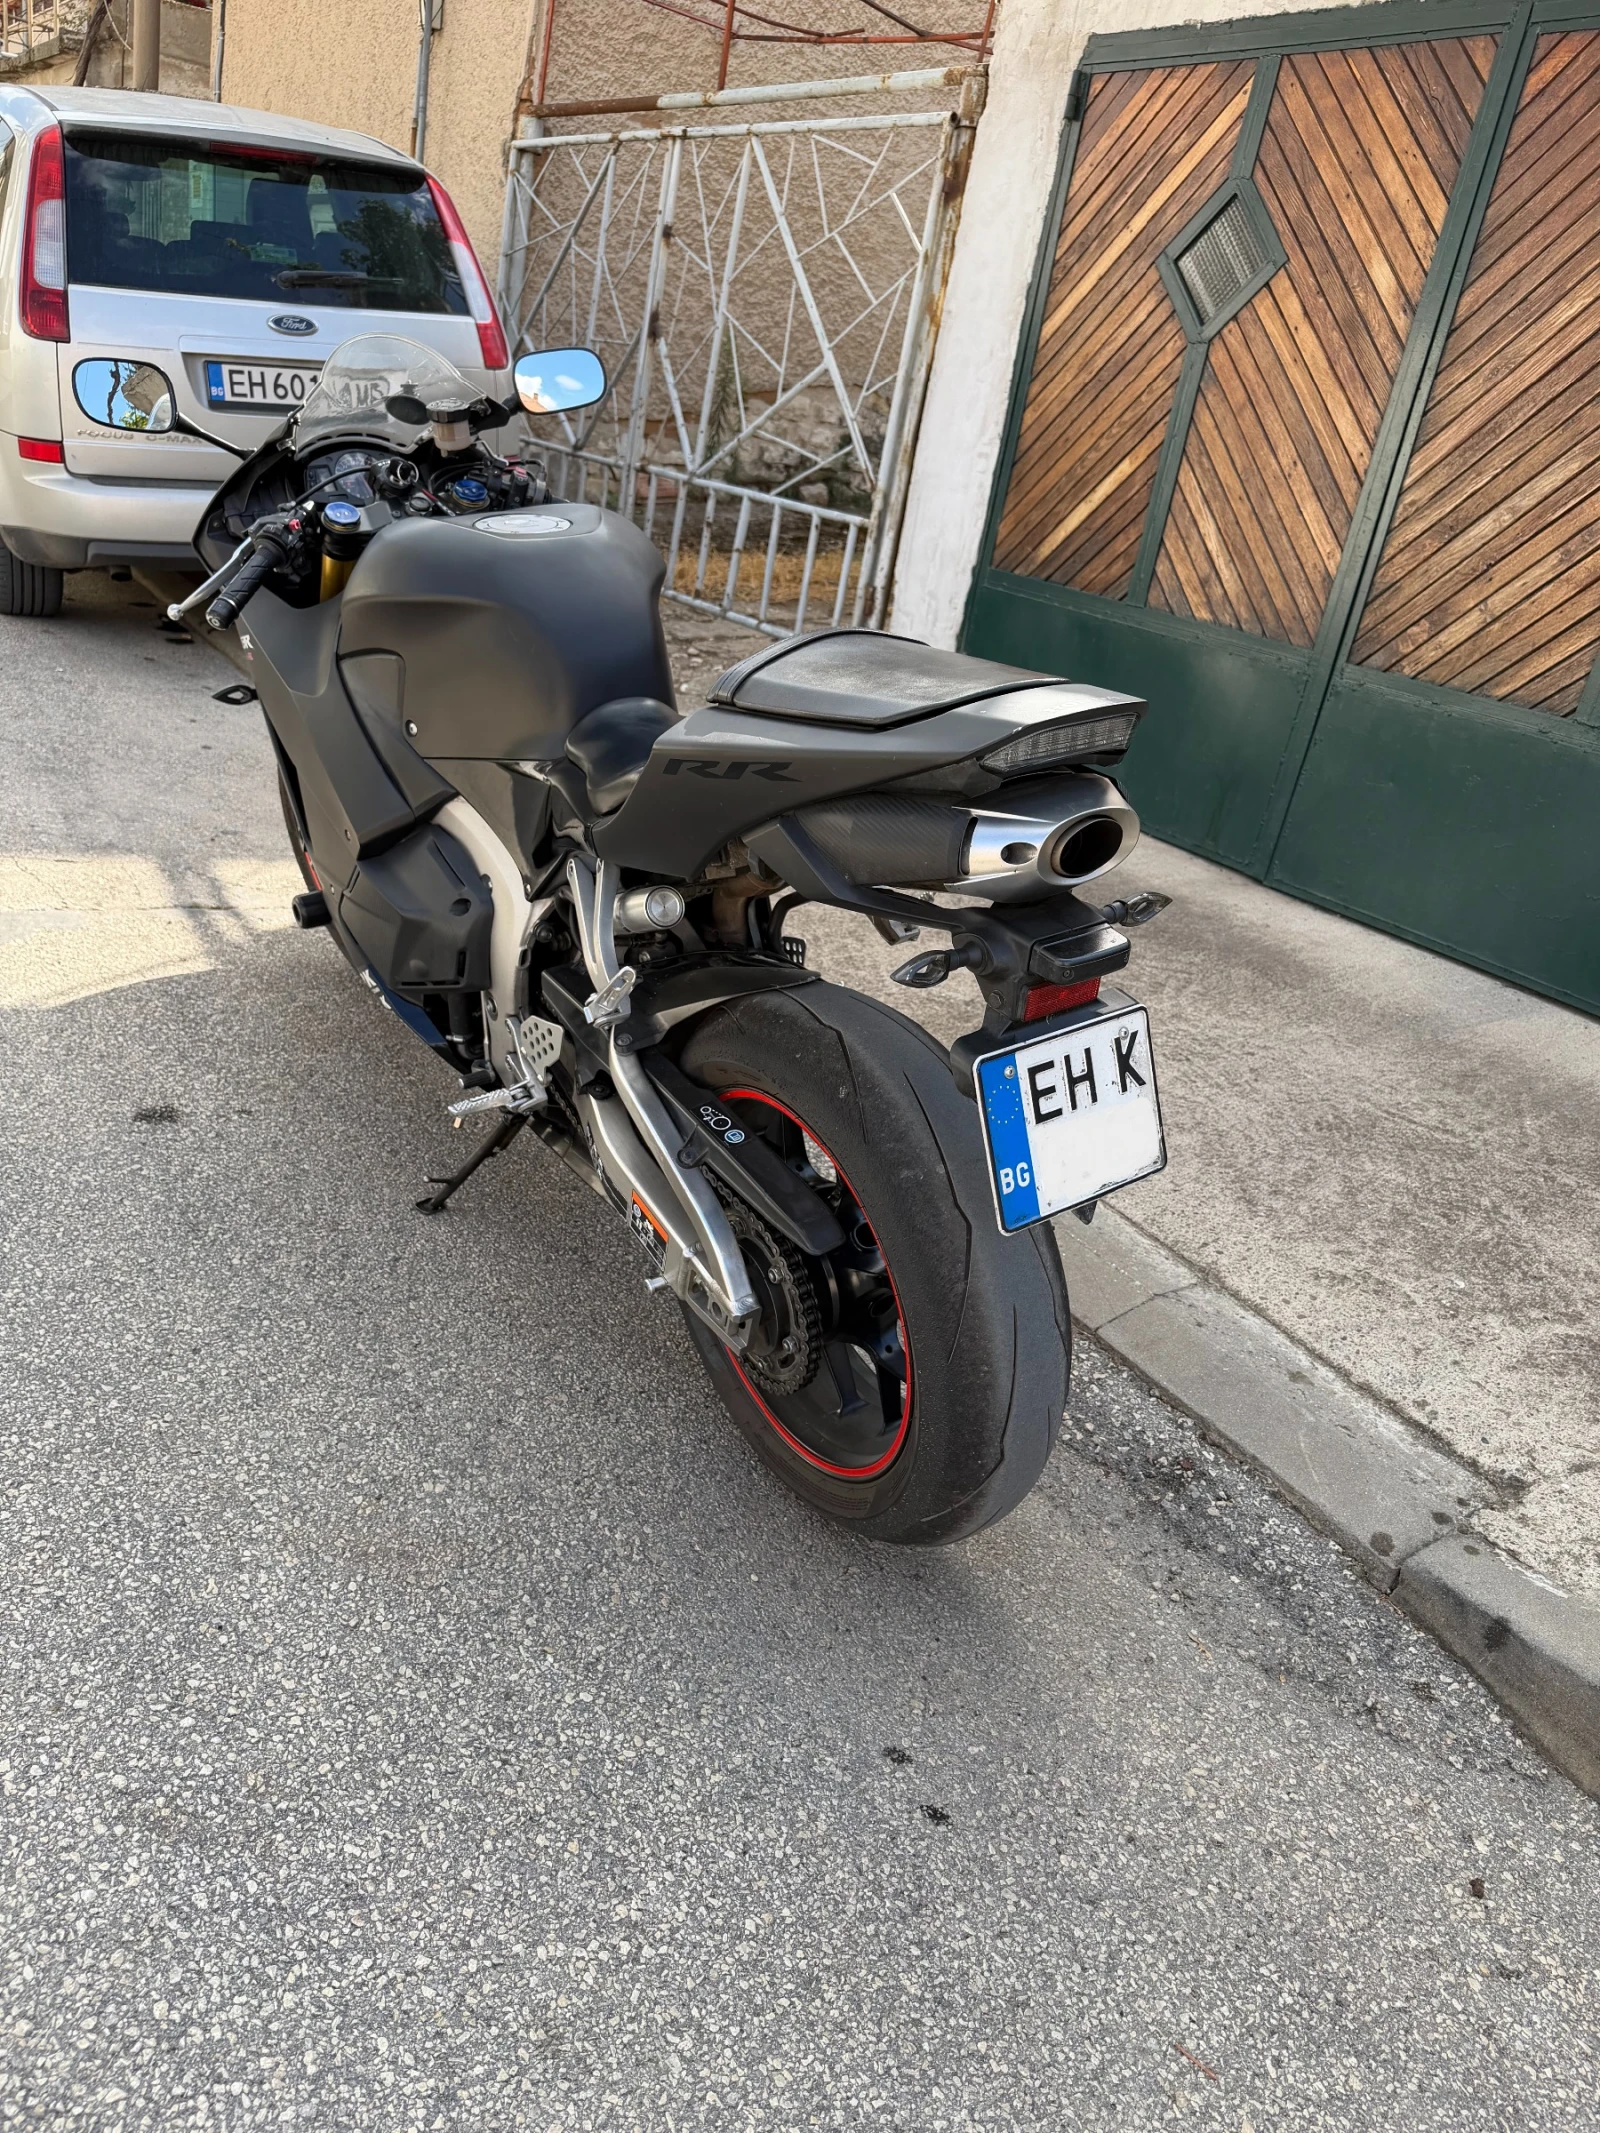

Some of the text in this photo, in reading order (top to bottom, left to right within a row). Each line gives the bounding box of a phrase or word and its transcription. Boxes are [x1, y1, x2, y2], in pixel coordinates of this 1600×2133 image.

[281, 317, 307, 330] Ford
[211, 387, 223, 396] BG
[229, 369, 267, 399] EH
[77, 429, 203, 443] FOCUS C-MAX
[662, 758, 803, 783] RR
[1027, 1030, 1147, 1125] EH K
[1000, 1161, 1031, 1195] BG
